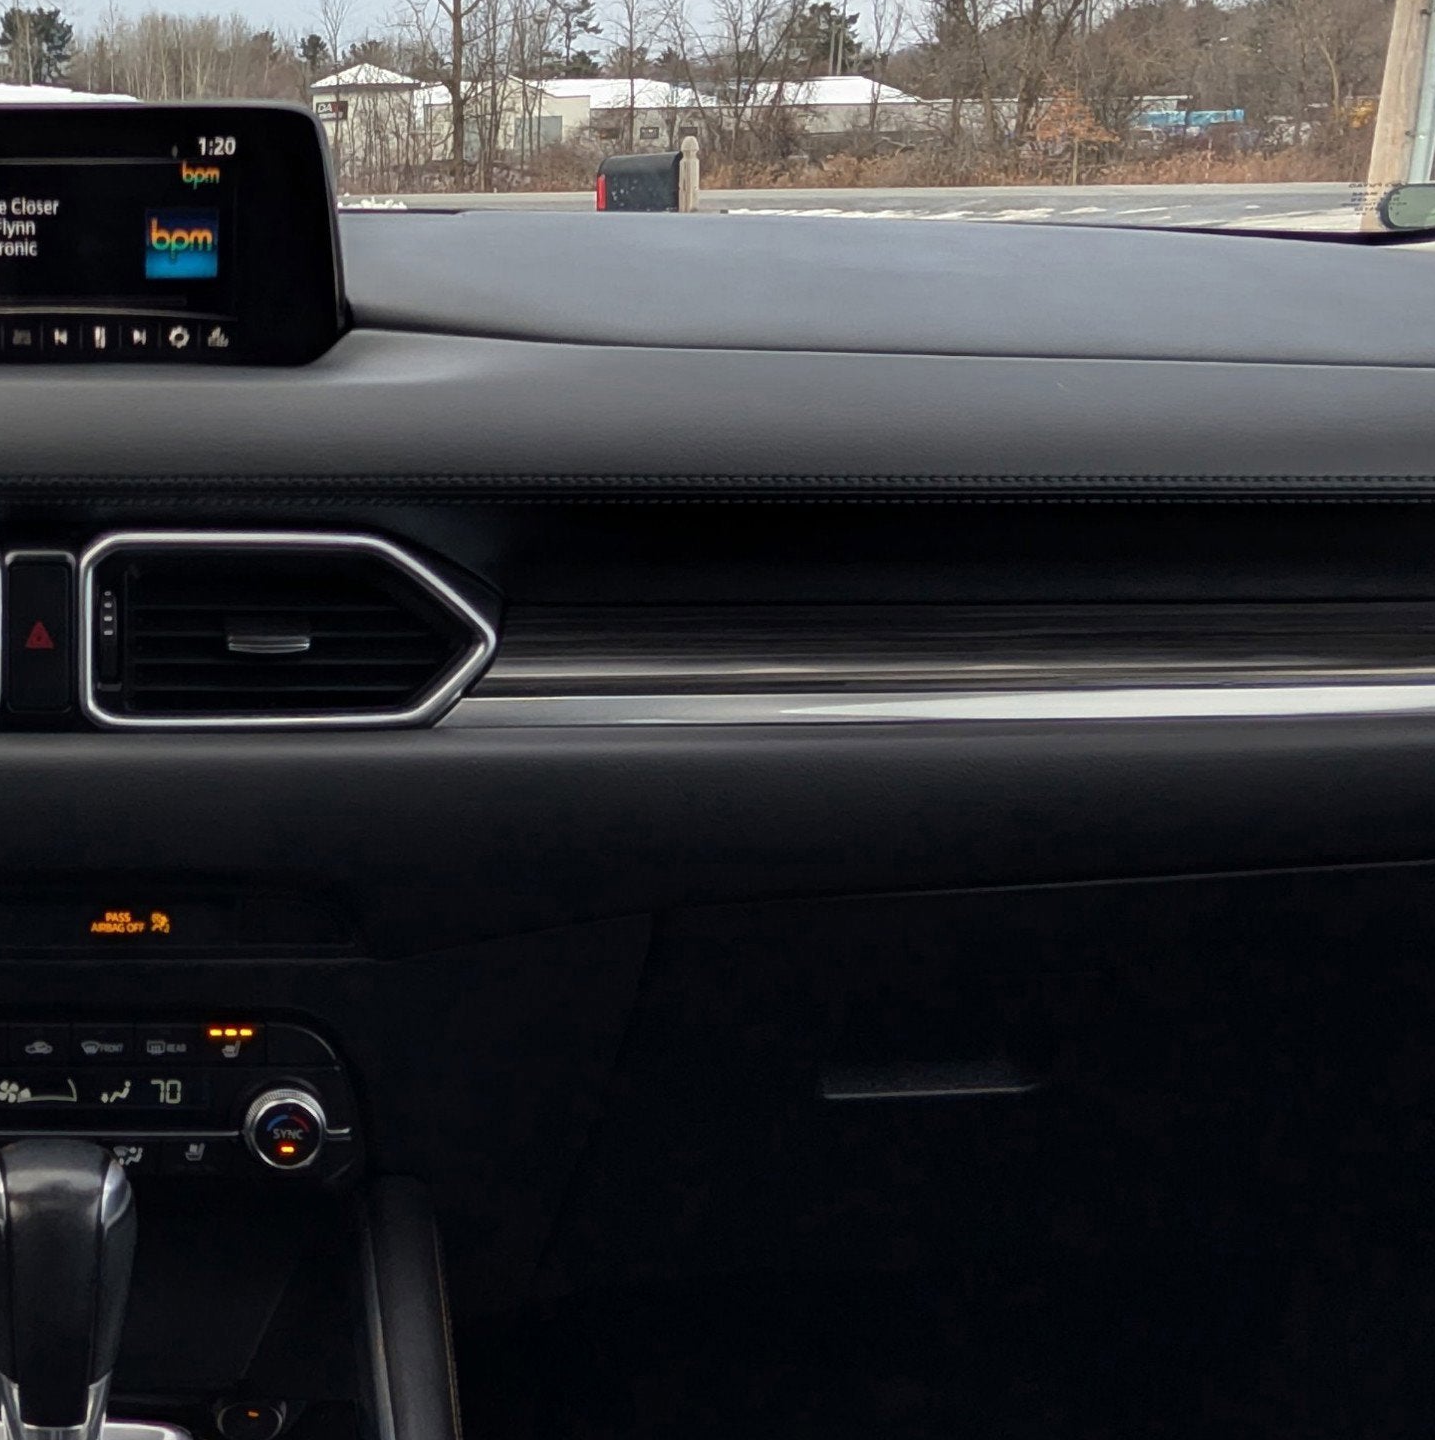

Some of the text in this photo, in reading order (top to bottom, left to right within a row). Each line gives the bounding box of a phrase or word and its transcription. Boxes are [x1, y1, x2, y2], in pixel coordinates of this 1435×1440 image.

[198, 136, 237, 156] 1:20
[181, 160, 221, 190] bpm
[11, 196, 60, 215] Closer
[151, 216, 214, 259] bpm
[105, 911, 131, 923] PASS
[91, 922, 146, 934] AIRBAG OFF
[150, 1078, 182, 1104] 70
[272, 1128, 304, 1141] SYNC
